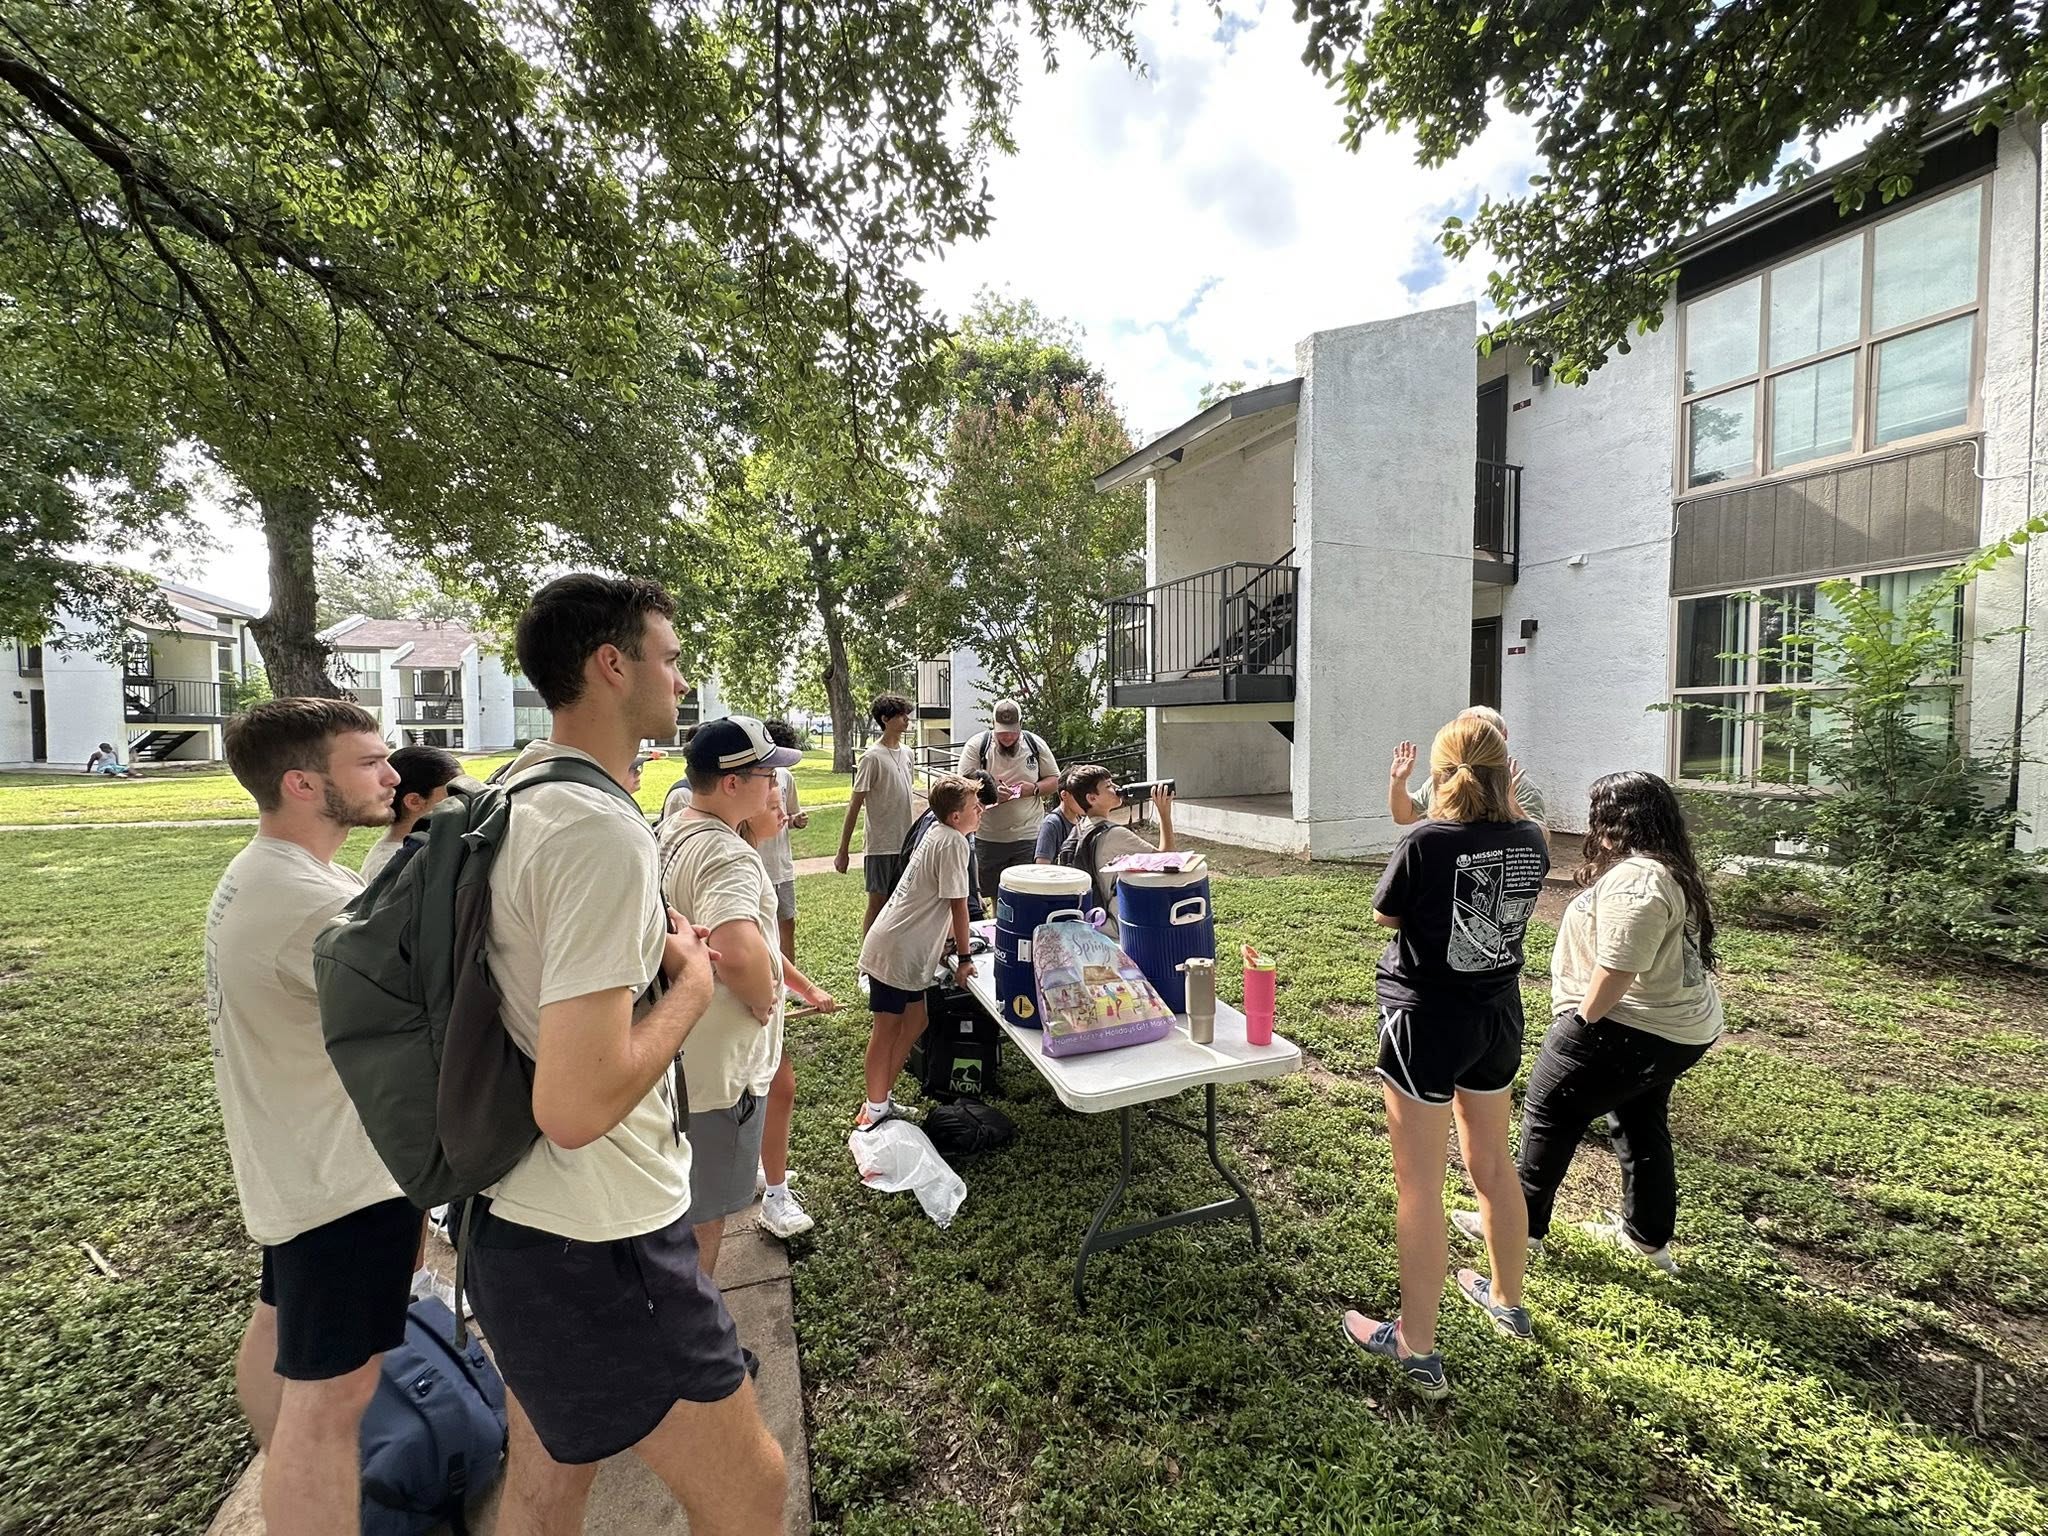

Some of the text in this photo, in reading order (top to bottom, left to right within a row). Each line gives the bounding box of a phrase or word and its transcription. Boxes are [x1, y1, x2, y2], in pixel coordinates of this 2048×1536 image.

[1472, 849, 1503, 859] MISSION
[1072, 932, 1111, 966] Spring
[1055, 1036, 1078, 1045] Home
[1091, 1032, 1103, 1040] the
[1105, 1026, 1136, 1037] Holidays
[1136, 1022, 1149, 1031] Gift
[949, 1079, 982, 1095] NCPN
